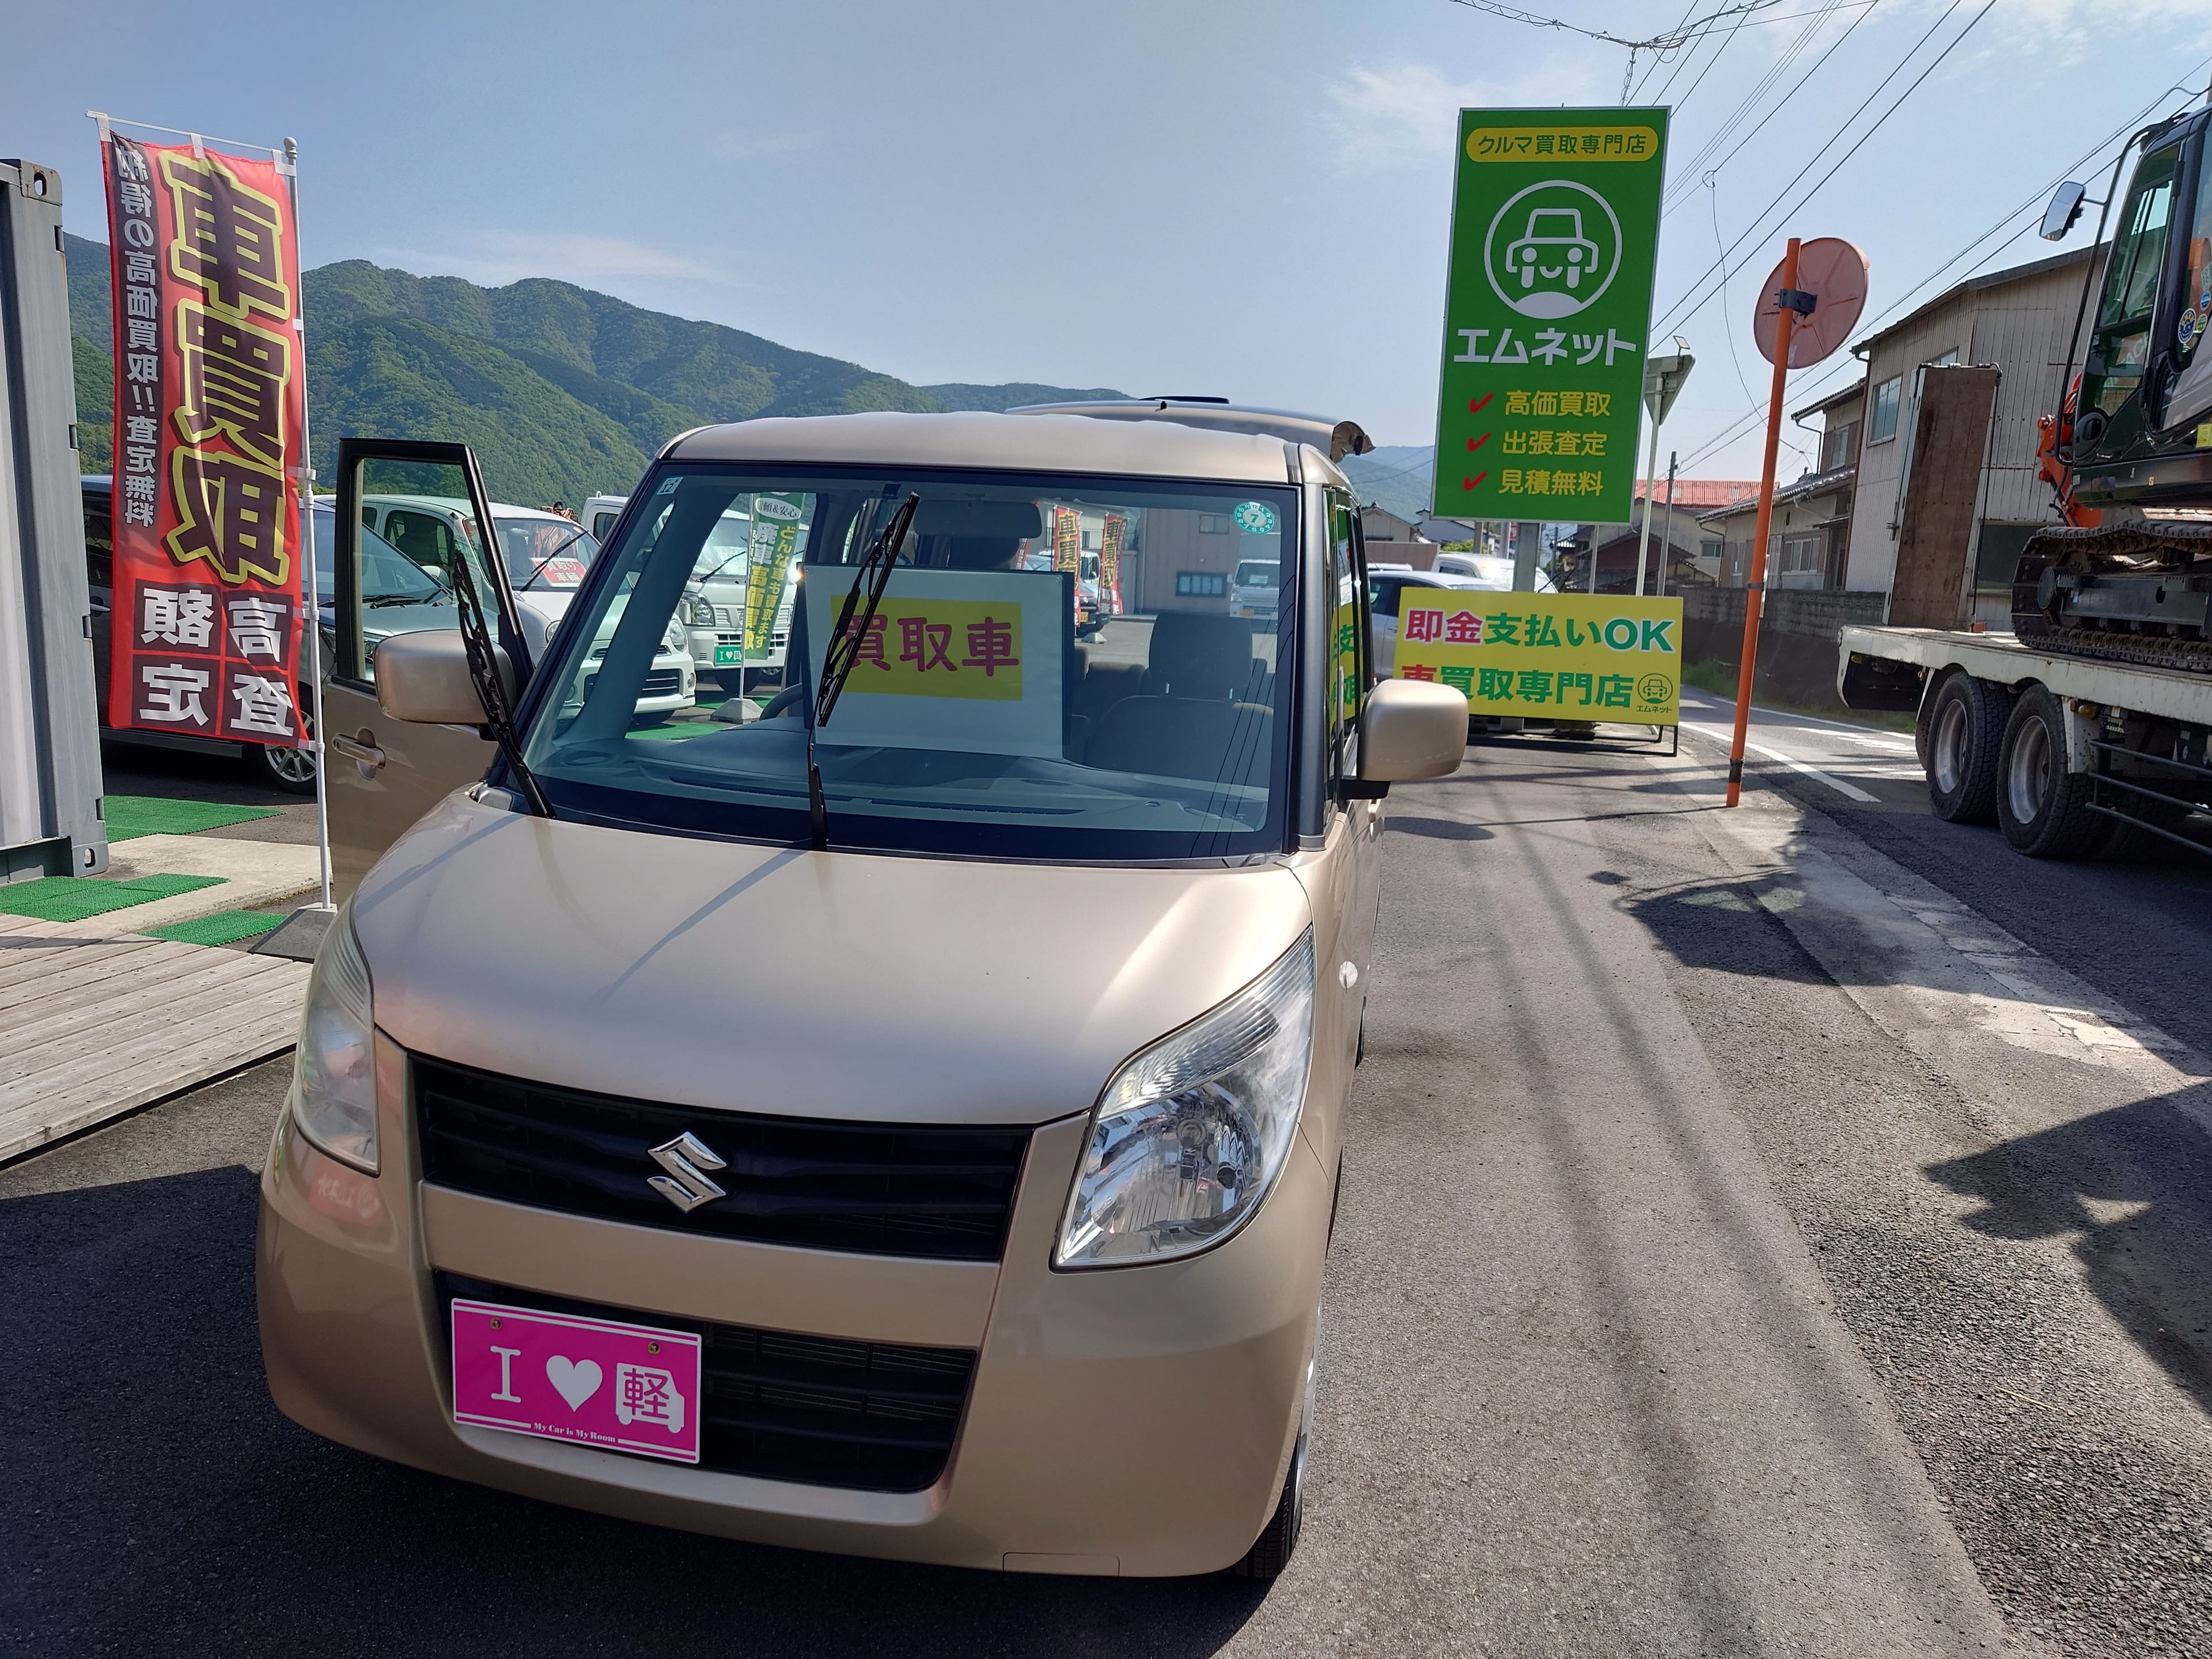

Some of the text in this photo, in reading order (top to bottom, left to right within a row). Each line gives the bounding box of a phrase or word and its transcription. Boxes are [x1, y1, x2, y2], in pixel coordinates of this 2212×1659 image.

[1477, 134, 1648, 155] クルマ買取専門店
[1454, 327, 1637, 366] エムネット
[1505, 389, 1612, 417] 高価買取
[1502, 429, 1608, 456] 出張査定
[1498, 469, 1604, 497] 見積無料
[1404, 608, 1675, 653] 即金支払いOK
[842, 614, 1020, 677] 買取車
[1636, 704, 1673, 714] エムネット
[490, 1345, 670, 1420] I 軽
[533, 1422, 615, 1443] My Car is My Room
